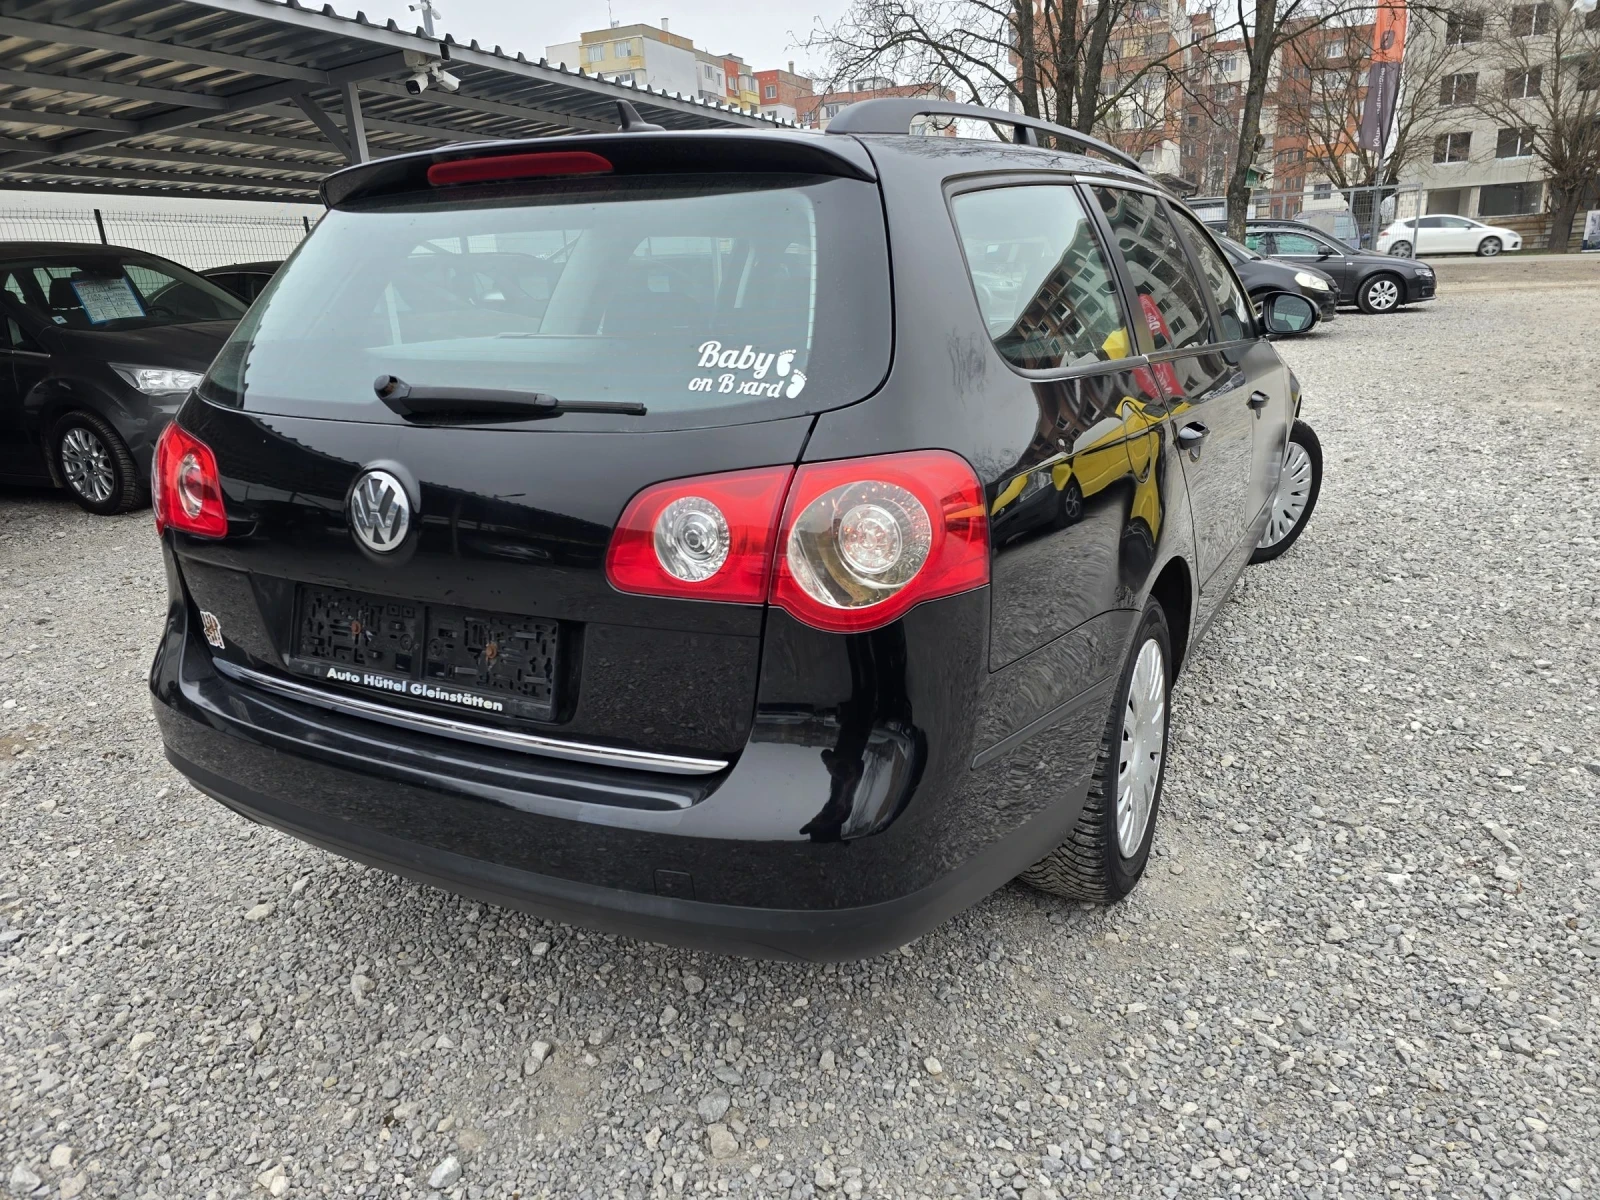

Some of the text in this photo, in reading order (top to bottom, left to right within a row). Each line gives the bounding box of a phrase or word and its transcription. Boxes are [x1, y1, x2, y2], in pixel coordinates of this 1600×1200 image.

[697, 340, 775, 379] Baby
[688, 373, 785, 398] on Bard
[352, 473, 408, 549] VW
[326, 667, 503, 711] Auto Hüttel Gleinstätten
